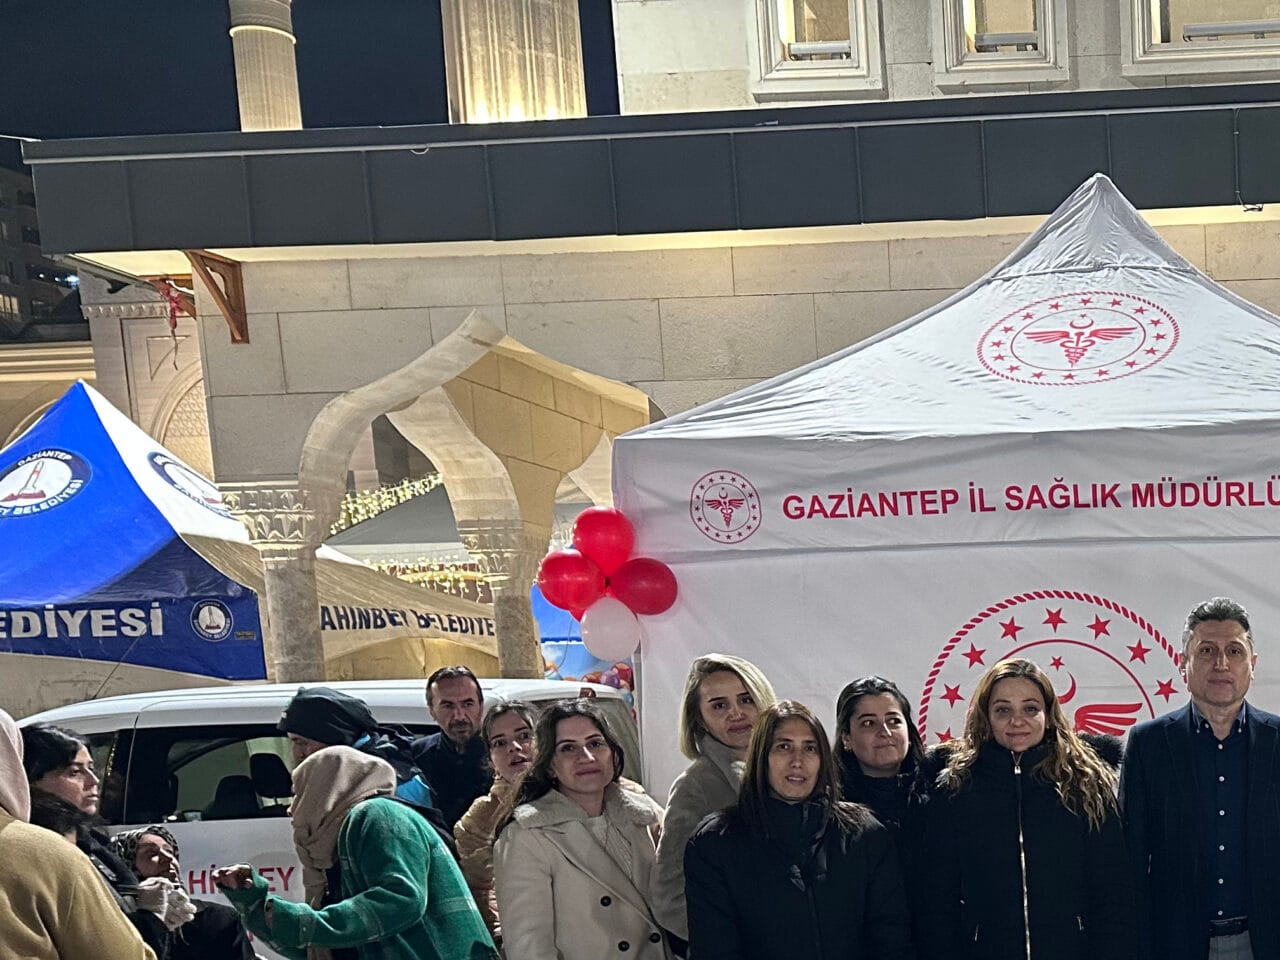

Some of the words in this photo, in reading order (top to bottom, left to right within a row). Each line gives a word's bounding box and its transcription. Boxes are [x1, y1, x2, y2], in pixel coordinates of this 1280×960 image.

[783, 488, 959, 519] GAZİANTEP
[969, 482, 996, 512] İL
[1005, 477, 1122, 511] SAĞLIK
[0, 602, 164, 638] DİYESİ
